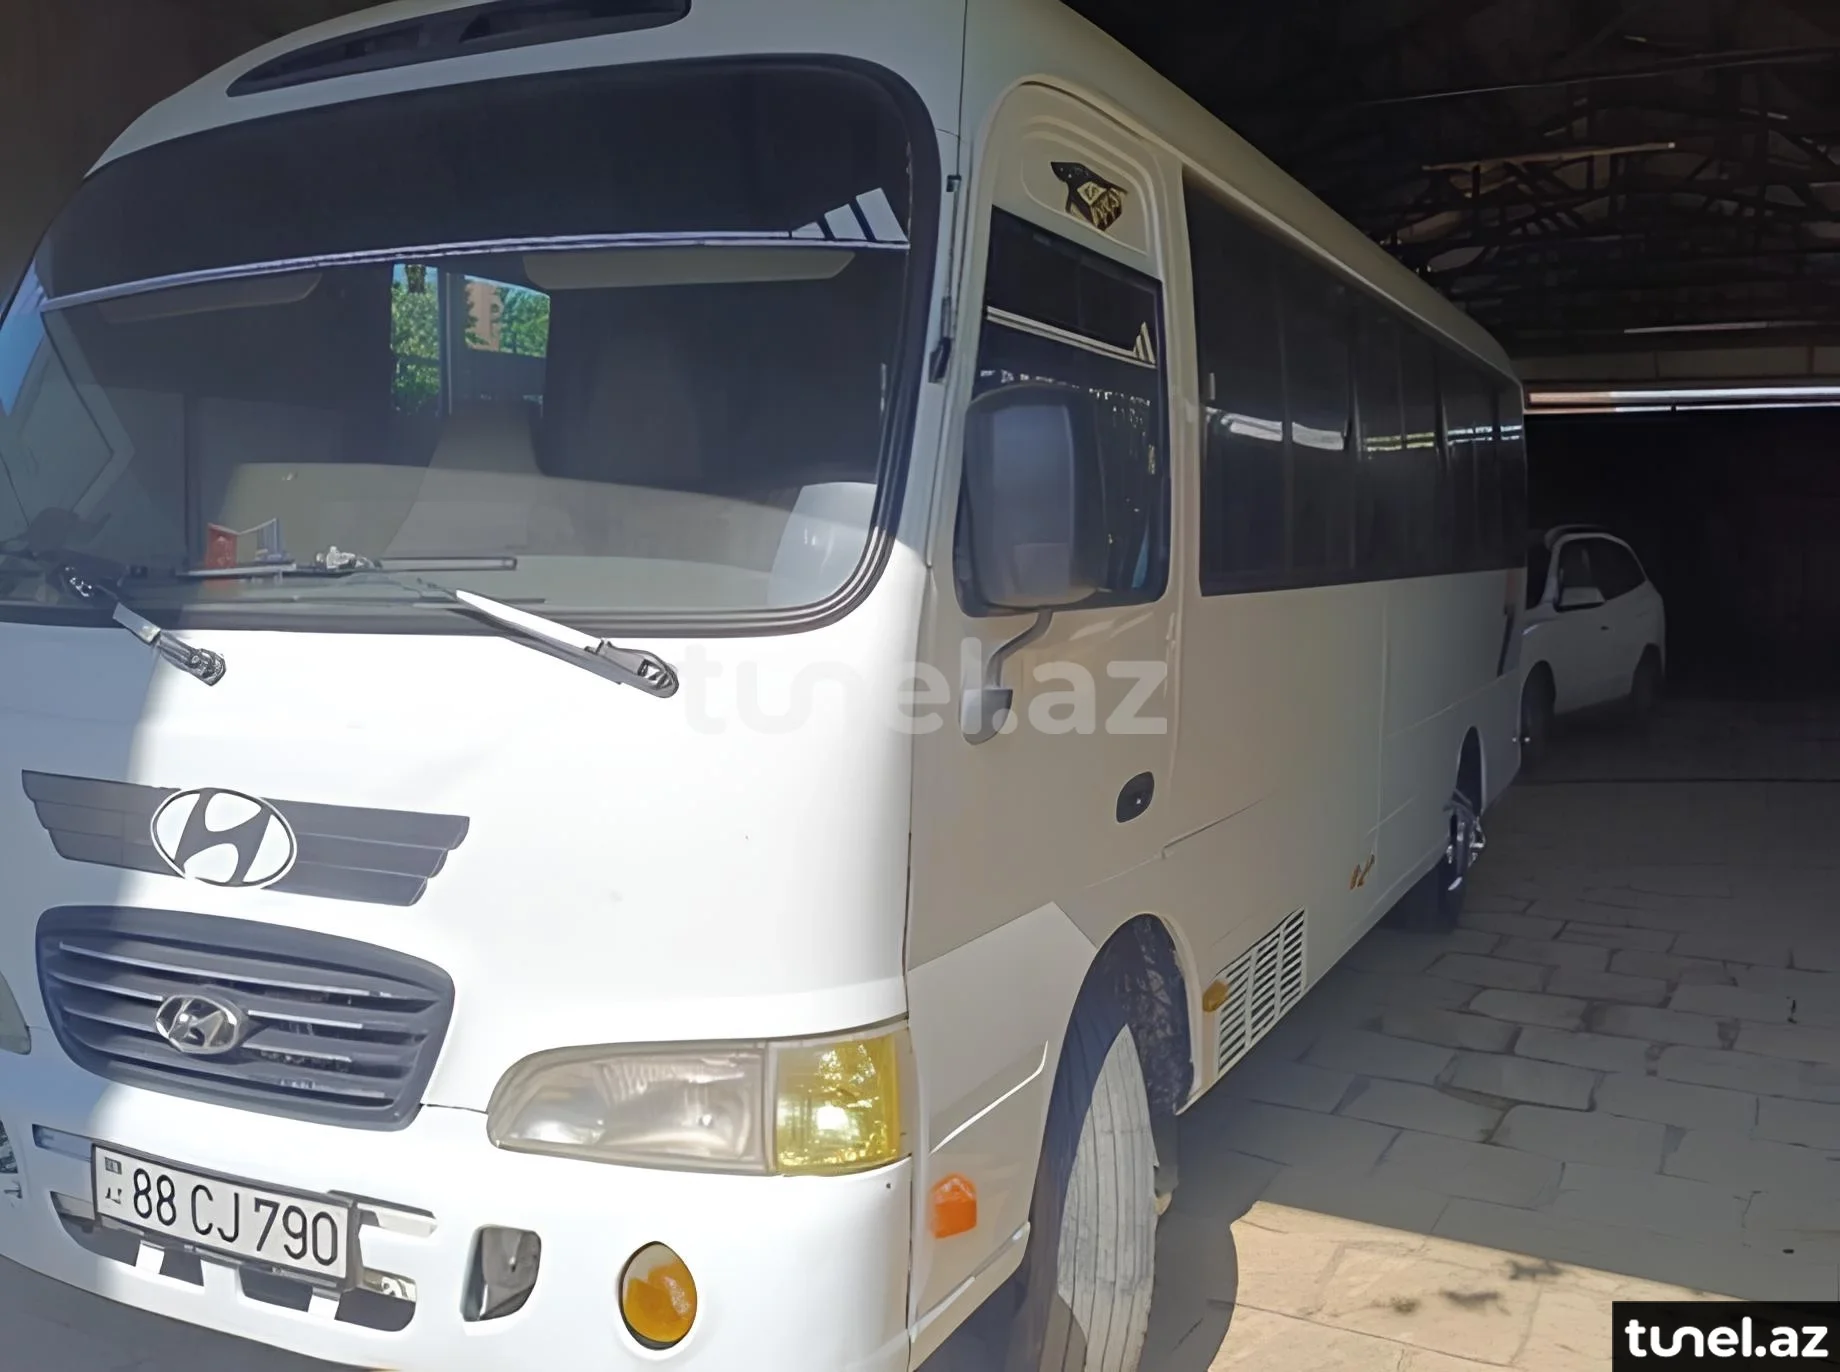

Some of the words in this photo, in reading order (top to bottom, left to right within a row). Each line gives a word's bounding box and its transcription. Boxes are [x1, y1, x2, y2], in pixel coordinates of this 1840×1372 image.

[133, 1168, 176, 1226] 88
[191, 1184, 239, 1243] CJ
[254, 1197, 338, 1266] 790
